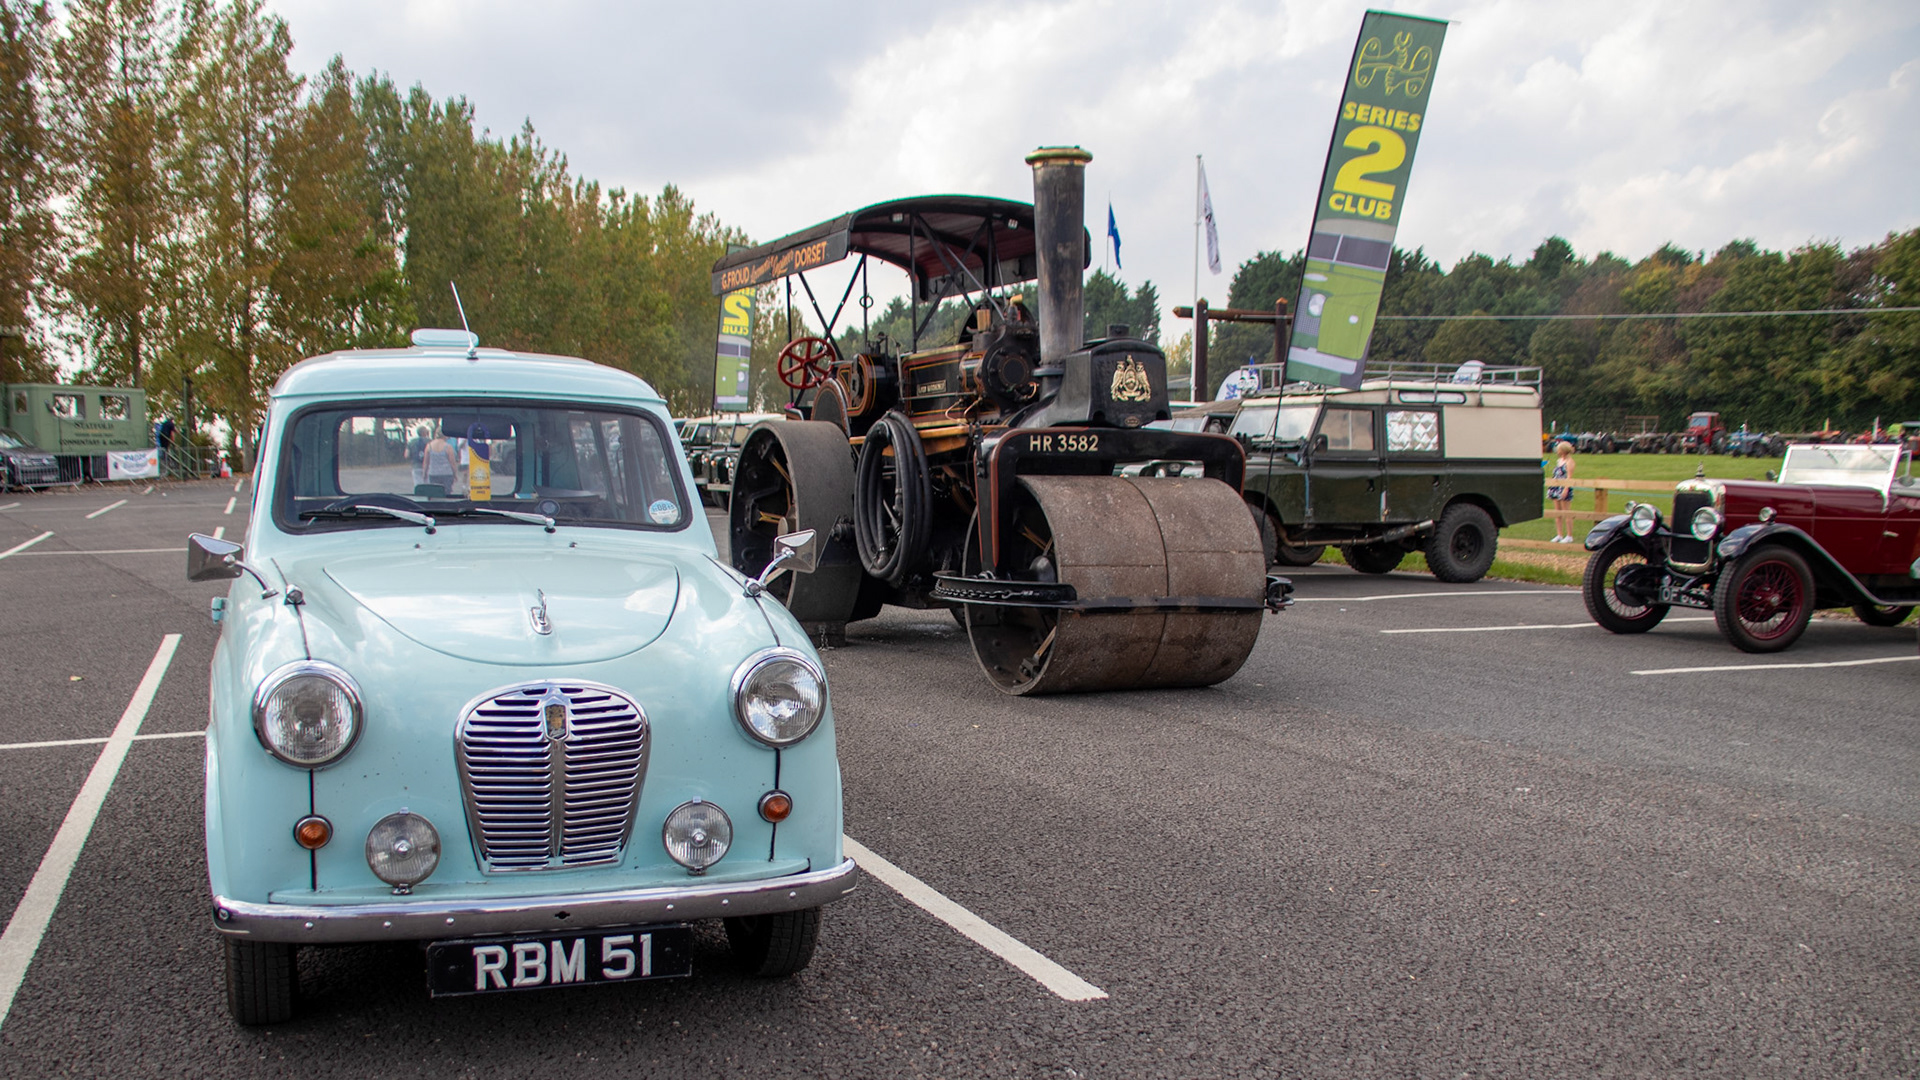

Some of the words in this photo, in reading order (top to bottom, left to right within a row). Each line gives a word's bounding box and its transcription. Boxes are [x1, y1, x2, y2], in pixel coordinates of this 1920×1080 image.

[1342, 101, 1421, 132] SERIES
[1333, 125, 1406, 201] 2
[1328, 193, 1392, 220] CLUB
[795, 241, 827, 270] DORSET
[1029, 435, 1053, 452] HR
[1057, 434, 1099, 452] 3582
[472, 938, 586, 990] RBM
[602, 933, 652, 980] 51
